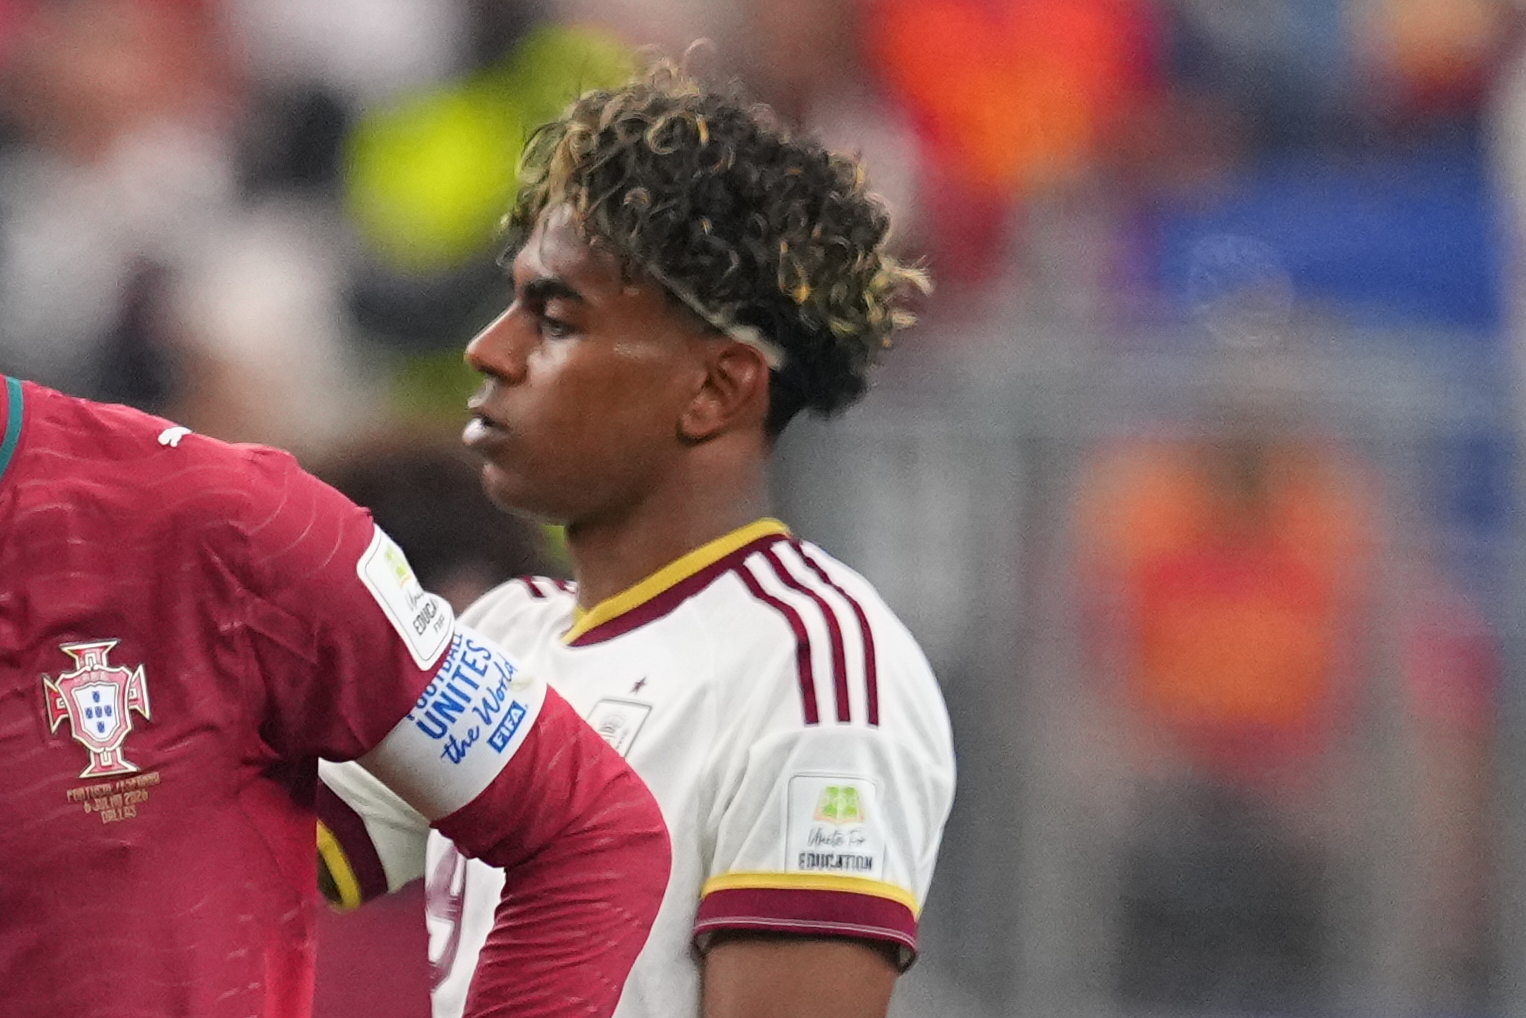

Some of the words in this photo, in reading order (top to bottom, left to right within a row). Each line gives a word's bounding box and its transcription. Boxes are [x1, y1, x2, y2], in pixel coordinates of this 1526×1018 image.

[415, 638, 492, 741] UNITES
[439, 725, 480, 765] the
[471, 651, 519, 727] World
[490, 703, 526, 750] FIFA
[798, 852, 873, 872] EDUCATION
